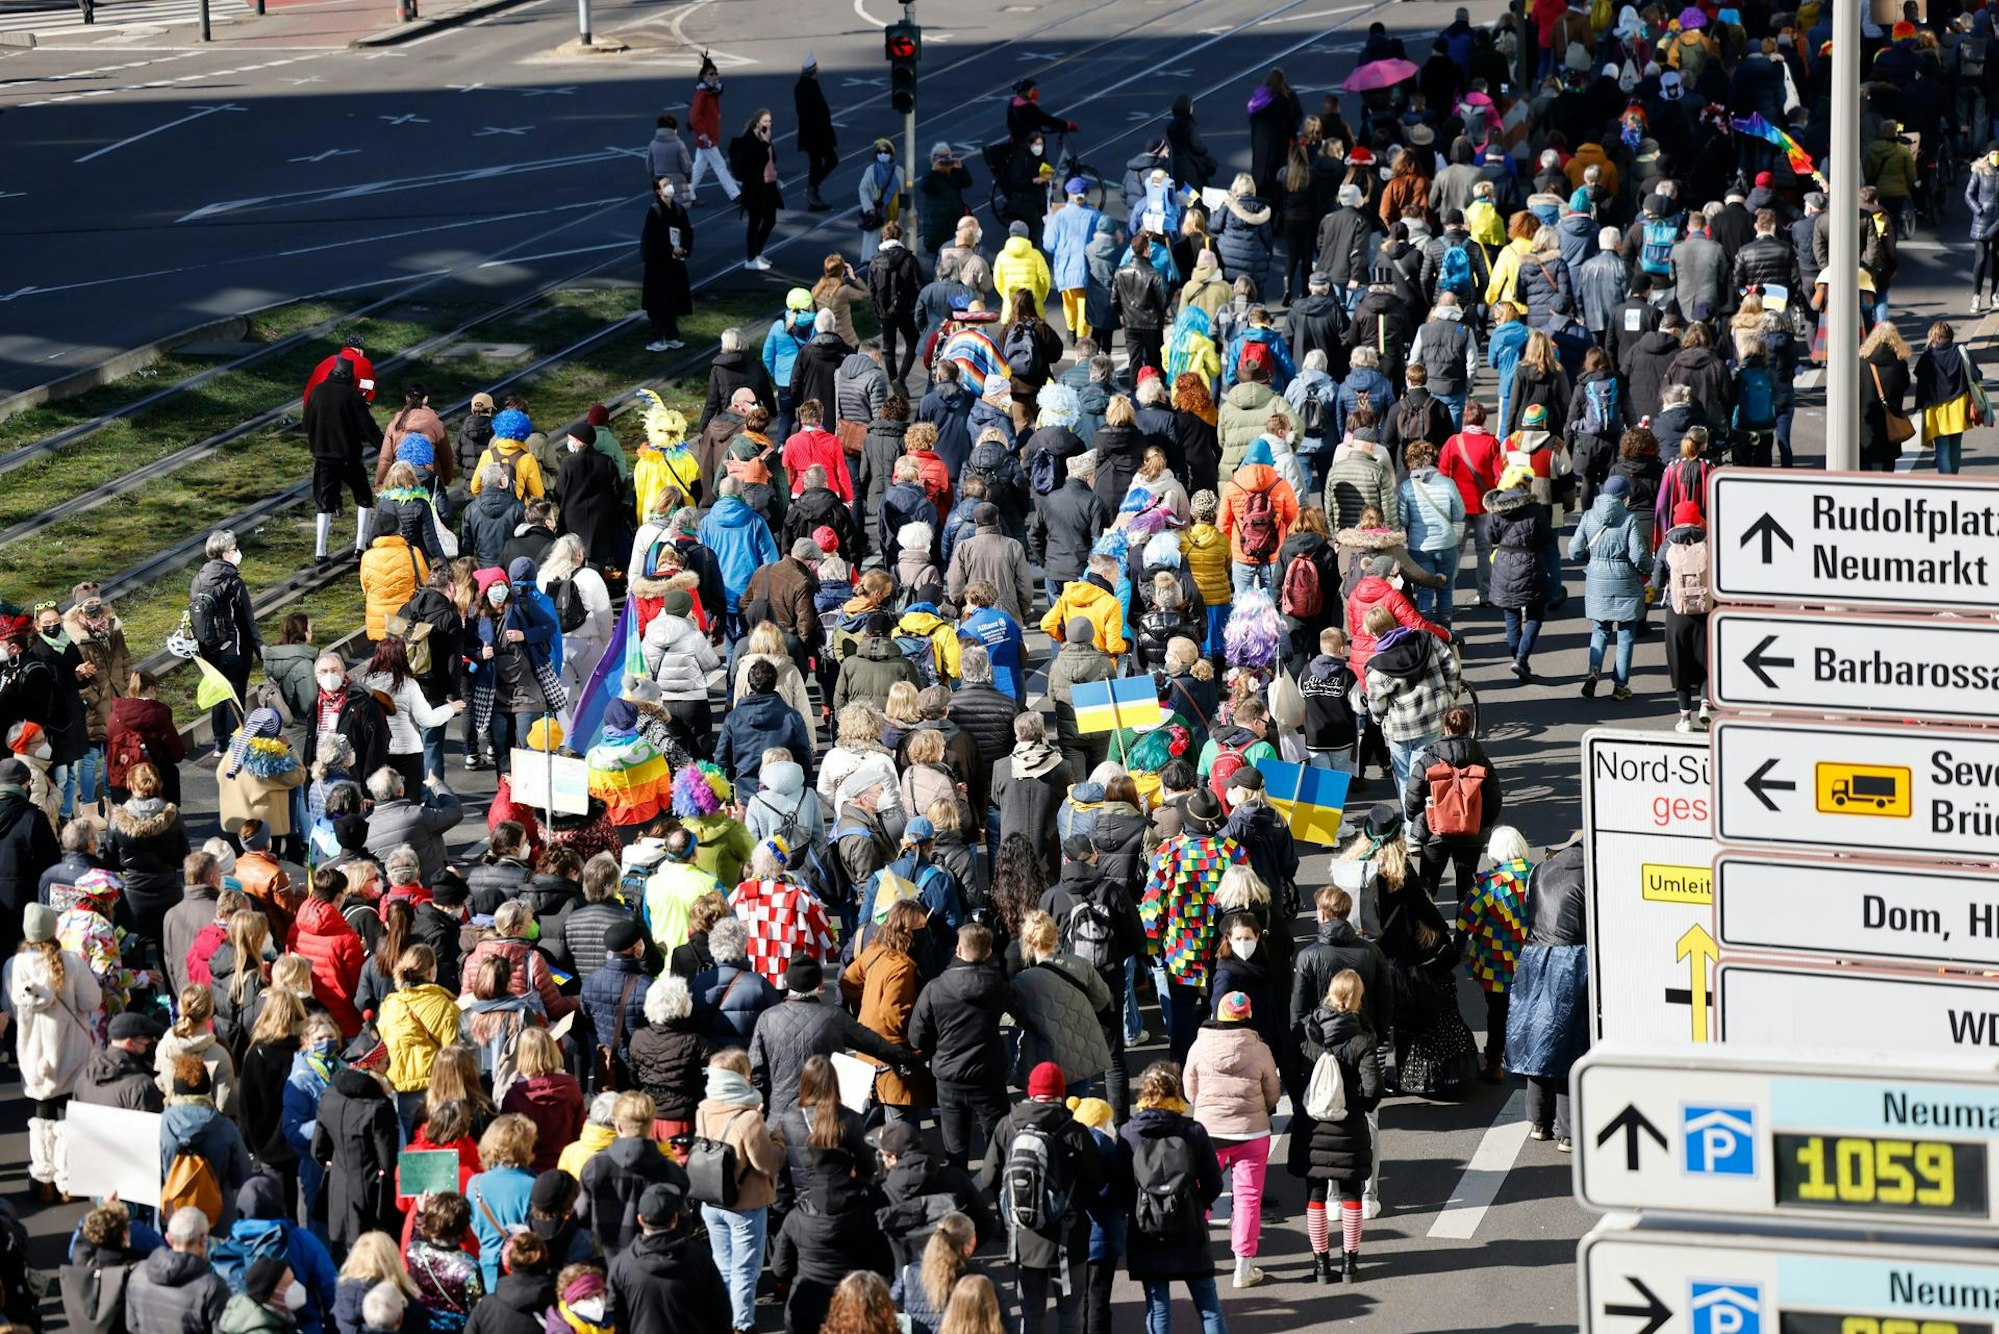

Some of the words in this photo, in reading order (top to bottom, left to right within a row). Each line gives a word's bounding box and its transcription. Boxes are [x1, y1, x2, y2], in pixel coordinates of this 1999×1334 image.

[1813, 495, 1999, 543] Rudolfplat
[1813, 544, 1989, 587] Neumarkt
[1931, 750, 1999, 788] Sev
[1652, 797, 1708, 827] ges
[1931, 799, 1999, 837] Brü
[1650, 874, 1712, 895] Umleit
[1863, 894, 1950, 942] Dom,
[1969, 902, 1999, 939] H
[1797, 1136, 1955, 1207] 1059
[1889, 1271, 1999, 1310] Neum
